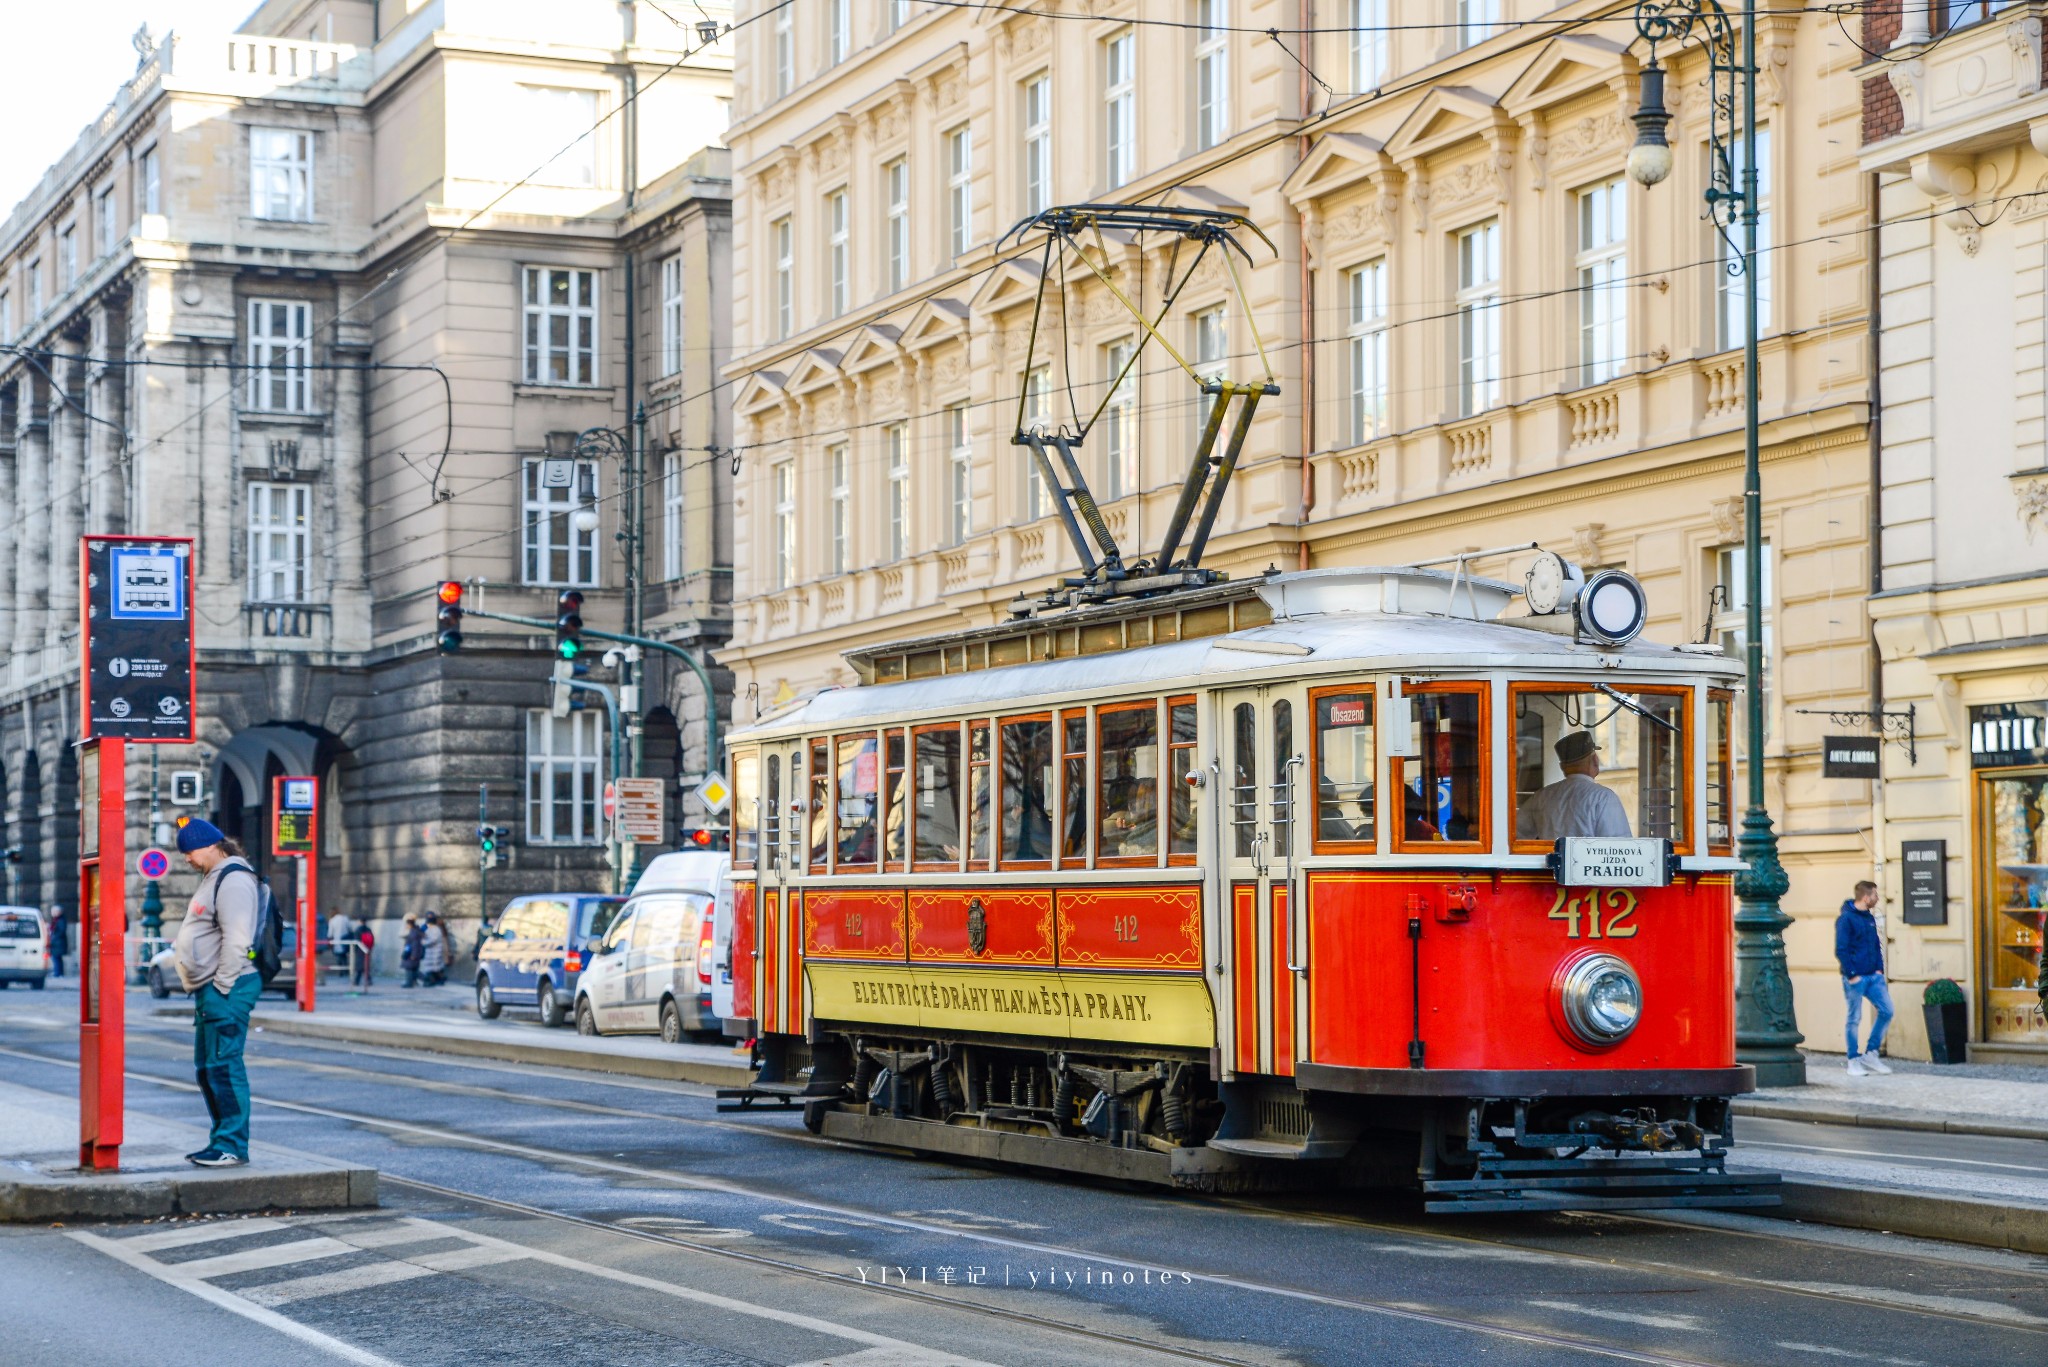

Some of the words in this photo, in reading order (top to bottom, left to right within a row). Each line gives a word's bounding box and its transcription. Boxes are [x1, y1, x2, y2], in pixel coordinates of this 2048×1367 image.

[1330, 706, 1365, 723] Obsazeno
[1586, 846, 1642, 856] VYHLÍDKOVÁ
[1601, 855, 1627, 864] JÍZDA
[1583, 866, 1644, 877] PRAHOU
[1547, 888, 1638, 939] 412
[845, 913, 862, 936] 412
[1114, 915, 1139, 942] 412
[853, 981, 940, 1008] ELEKTRICKÉ
[940, 983, 988, 1012] DRÁHY
[1084, 993, 1152, 1021] PRAHY.
